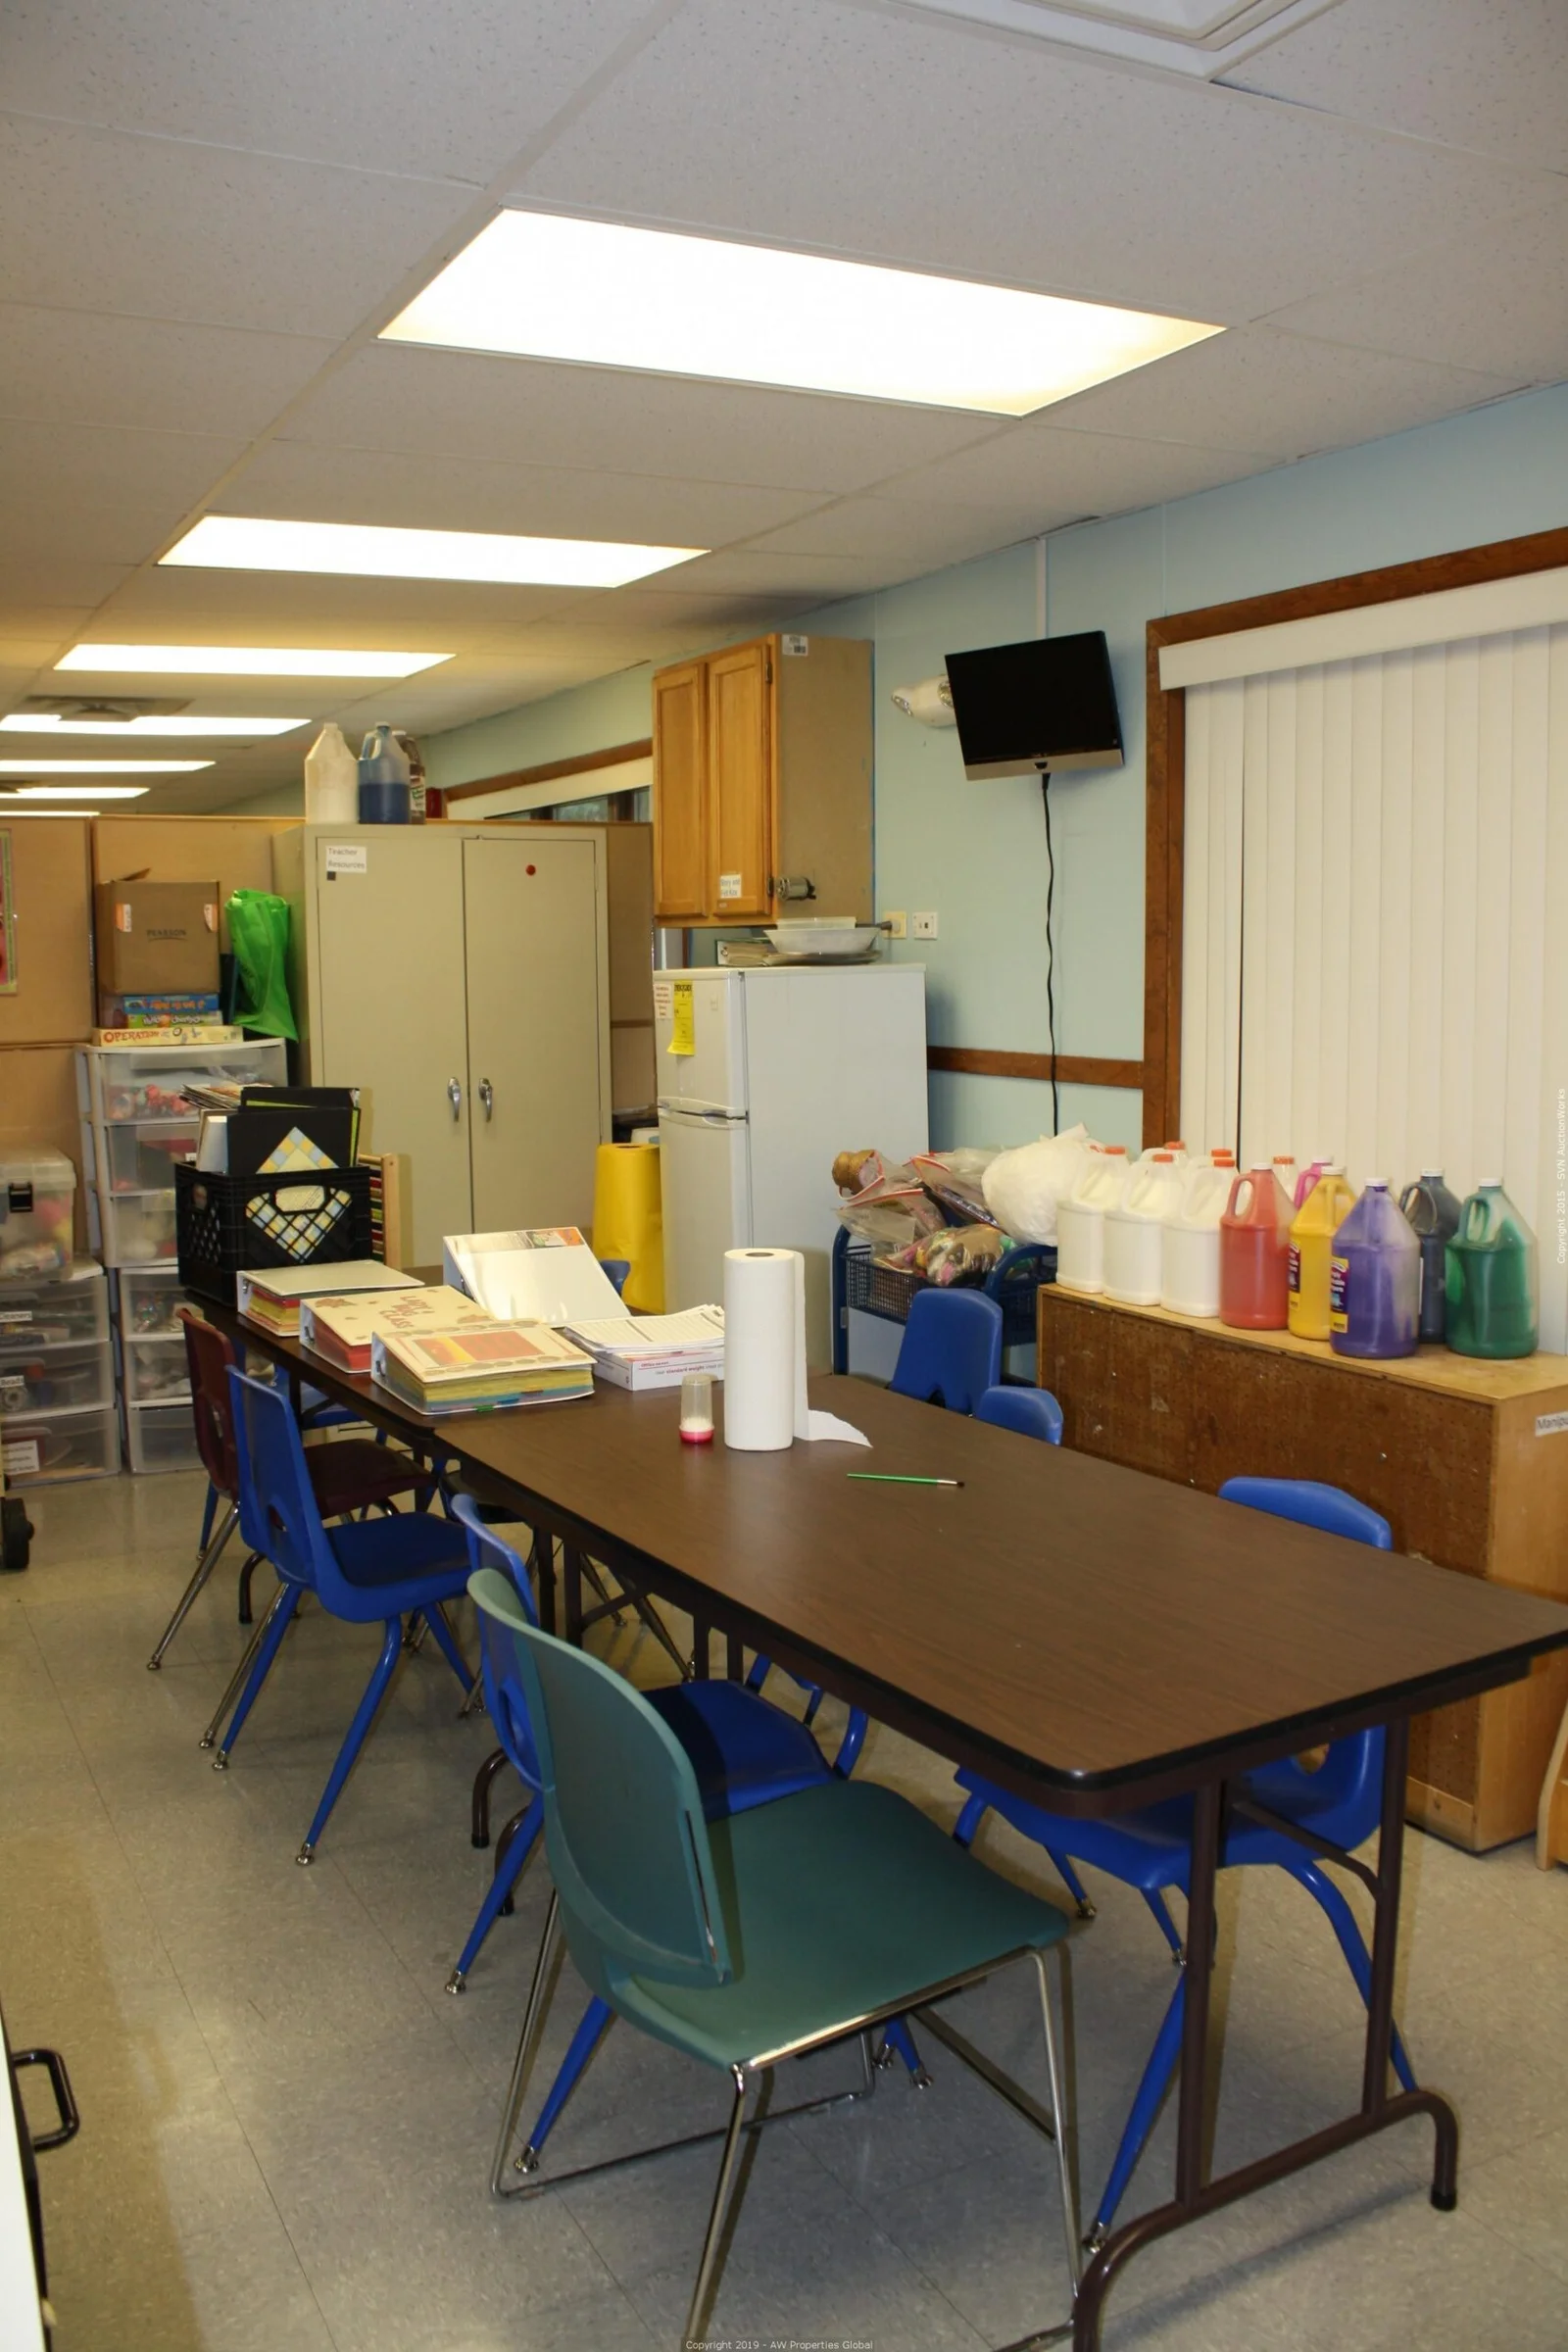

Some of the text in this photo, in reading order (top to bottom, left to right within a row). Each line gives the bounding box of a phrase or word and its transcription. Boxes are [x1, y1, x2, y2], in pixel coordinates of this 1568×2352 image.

[327, 860, 366, 869] Resources
[147, 928, 187, 937] PEARSON
[103, 1030, 160, 1044] OPERATION
